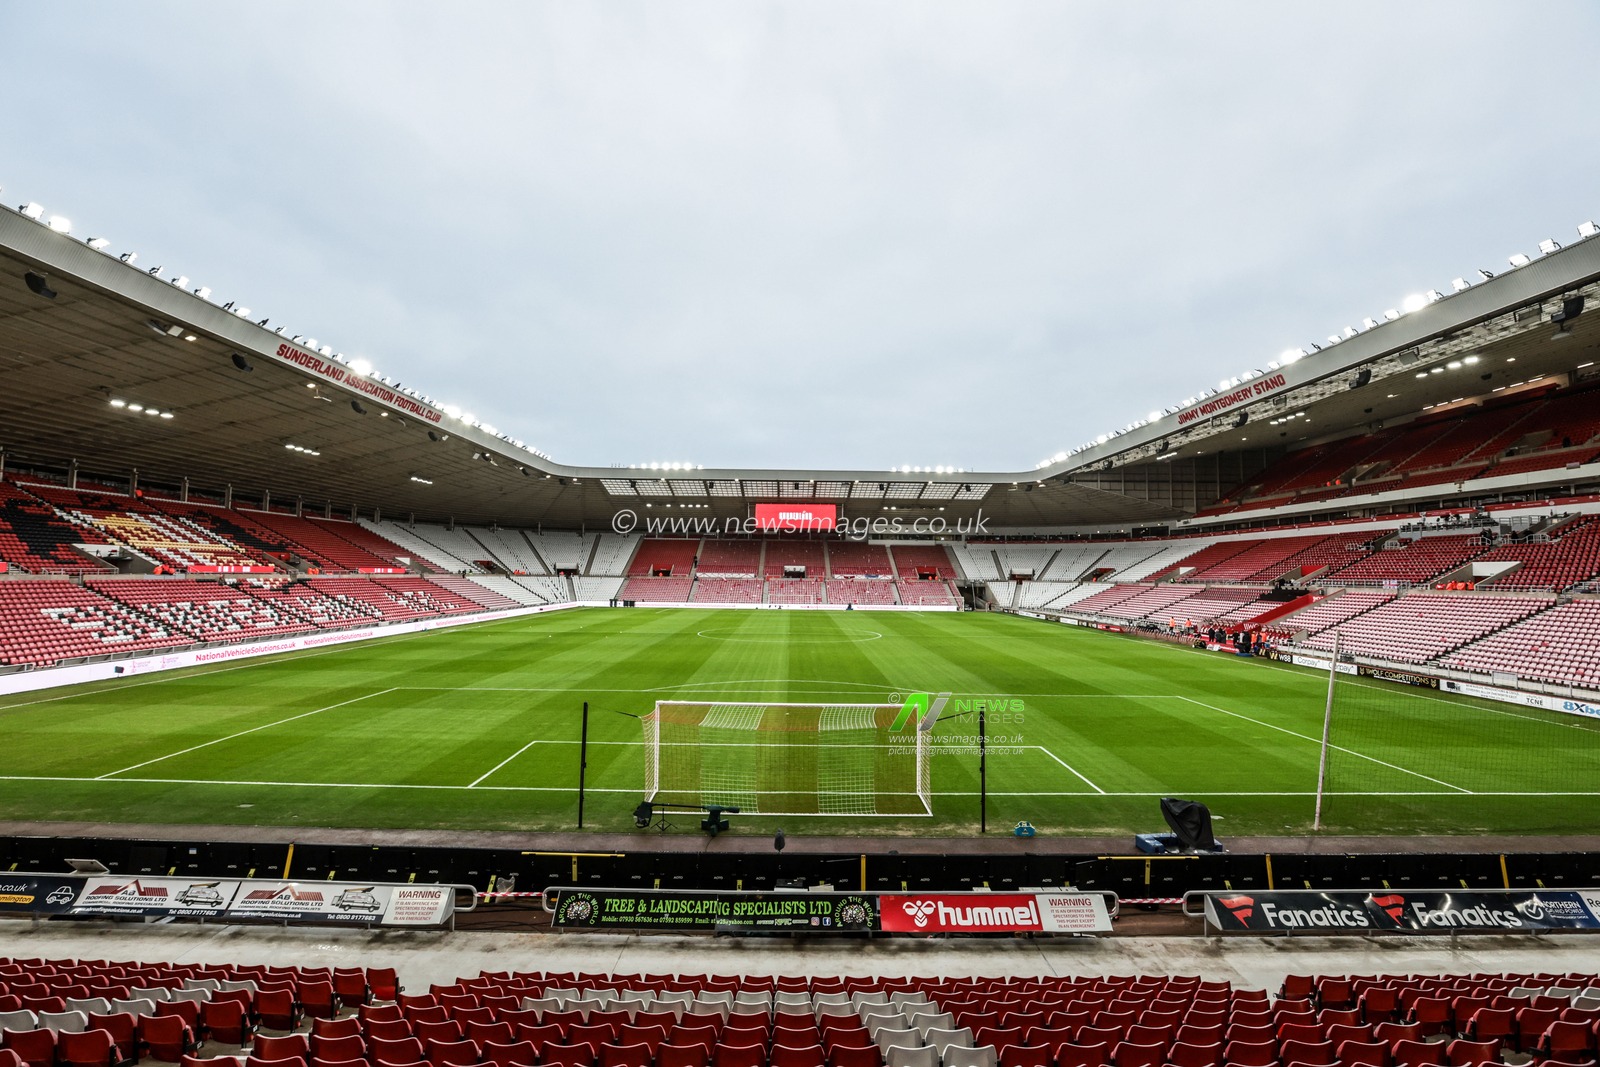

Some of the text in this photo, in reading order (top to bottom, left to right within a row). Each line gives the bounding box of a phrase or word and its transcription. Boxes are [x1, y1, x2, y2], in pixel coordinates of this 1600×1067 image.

[276, 343, 442, 423] SUNDERLAND ASSOCIATION FOOTBALL CLUB
[1178, 373, 1286, 425] JIMMY MONTGOMERY STAND
[195, 641, 296, 662] NationalVehicleSolutions.co.uk
[1328, 661, 1352, 673] Crpay
[1384, 671, 1430, 685] COMPETITIONS
[1526, 697, 1544, 706] TCNE
[398, 890, 442, 899] WARNING
[1048, 898, 1092, 906] WARNING
[559, 893, 600, 925] AROUND THE WORLD
[604, 898, 832, 916] TREE & LANDSCAPING SPECIALISTS LTD
[834, 896, 874, 928] AROUND THE WORLD
[937, 900, 1039, 926] hummel
[1542, 900, 1582, 909] NORTHERN
[601, 915, 618, 923] Mobile:
[1260, 902, 1370, 928] Fanatics
[1410, 901, 1523, 928] Fanatics
